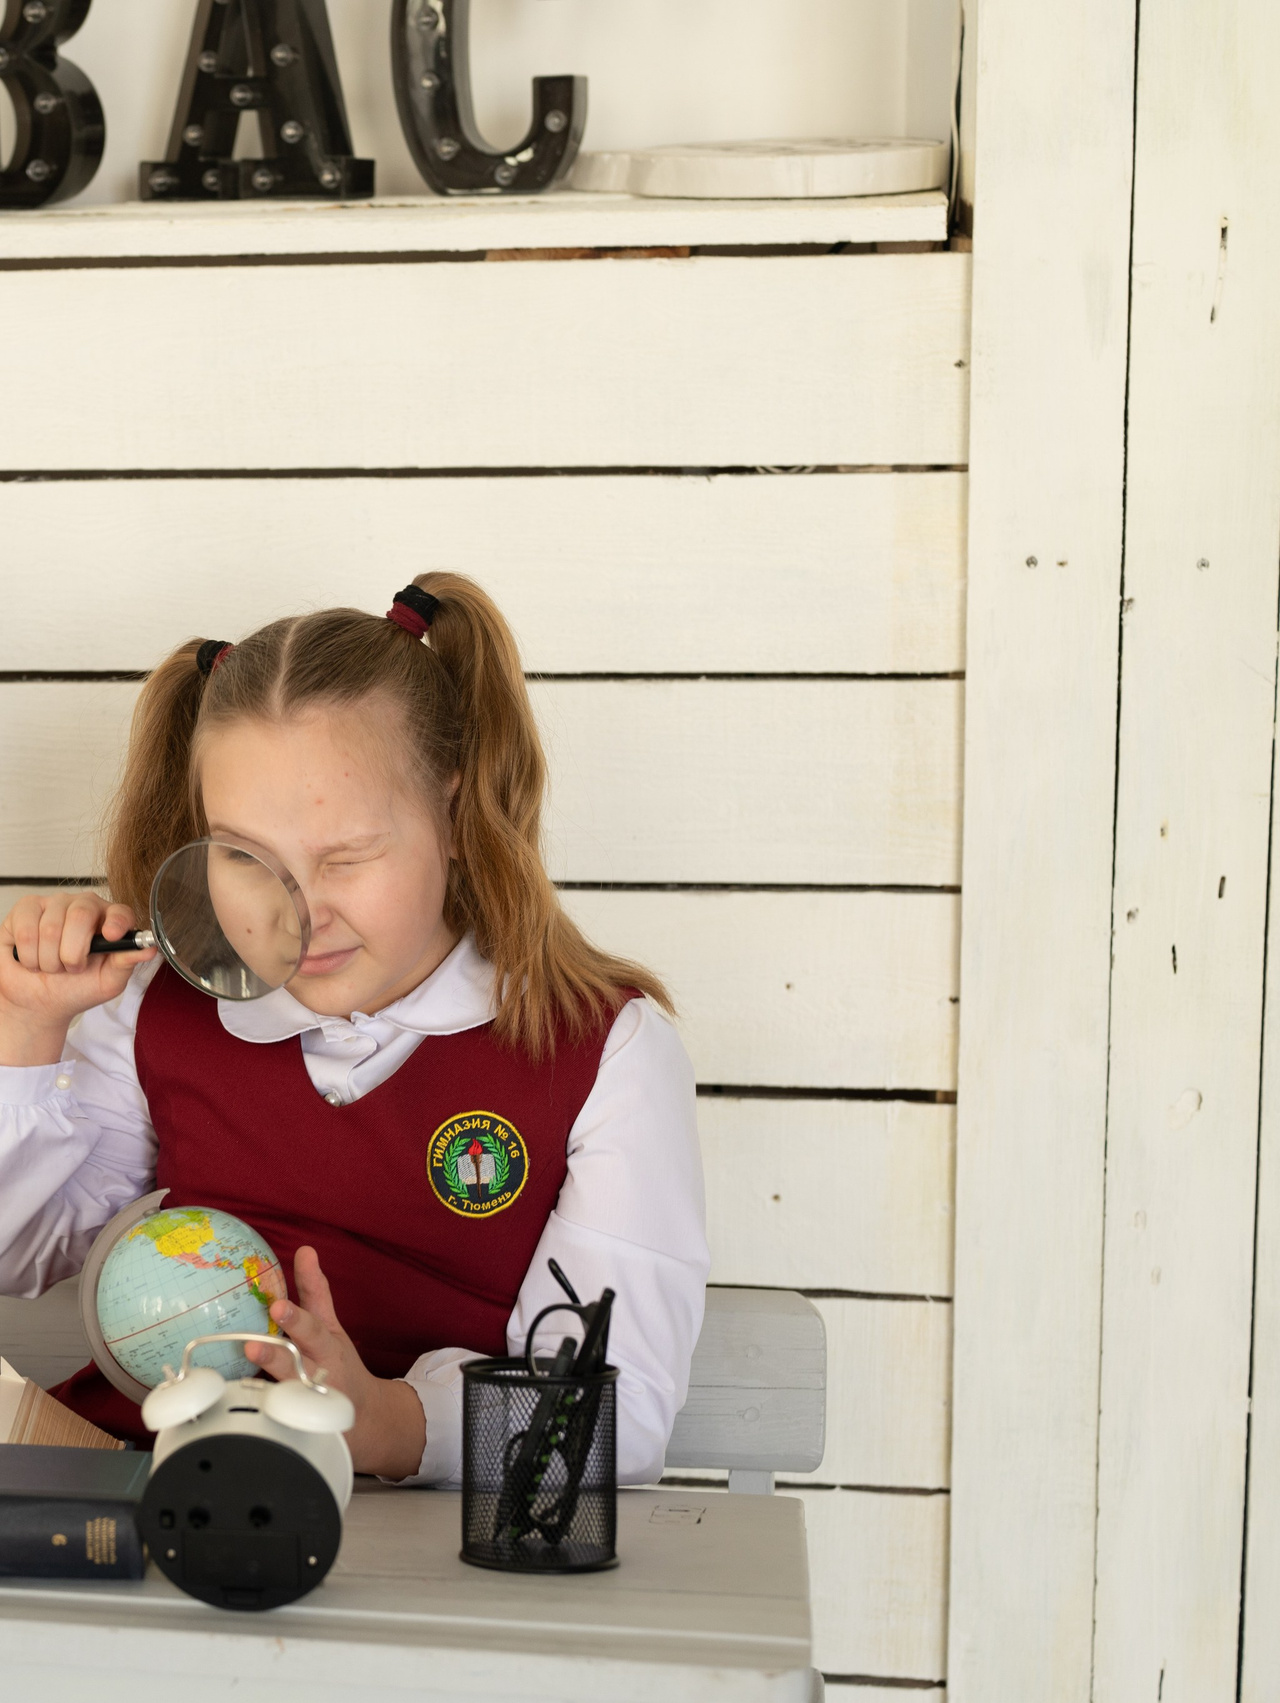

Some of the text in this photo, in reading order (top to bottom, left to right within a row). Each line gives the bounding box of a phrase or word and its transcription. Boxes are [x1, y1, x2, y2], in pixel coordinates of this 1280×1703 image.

[432, 1117, 520, 1167] ГИМНАЗИЯ № 16
[447, 1191, 512, 1211] г. Тюмень
